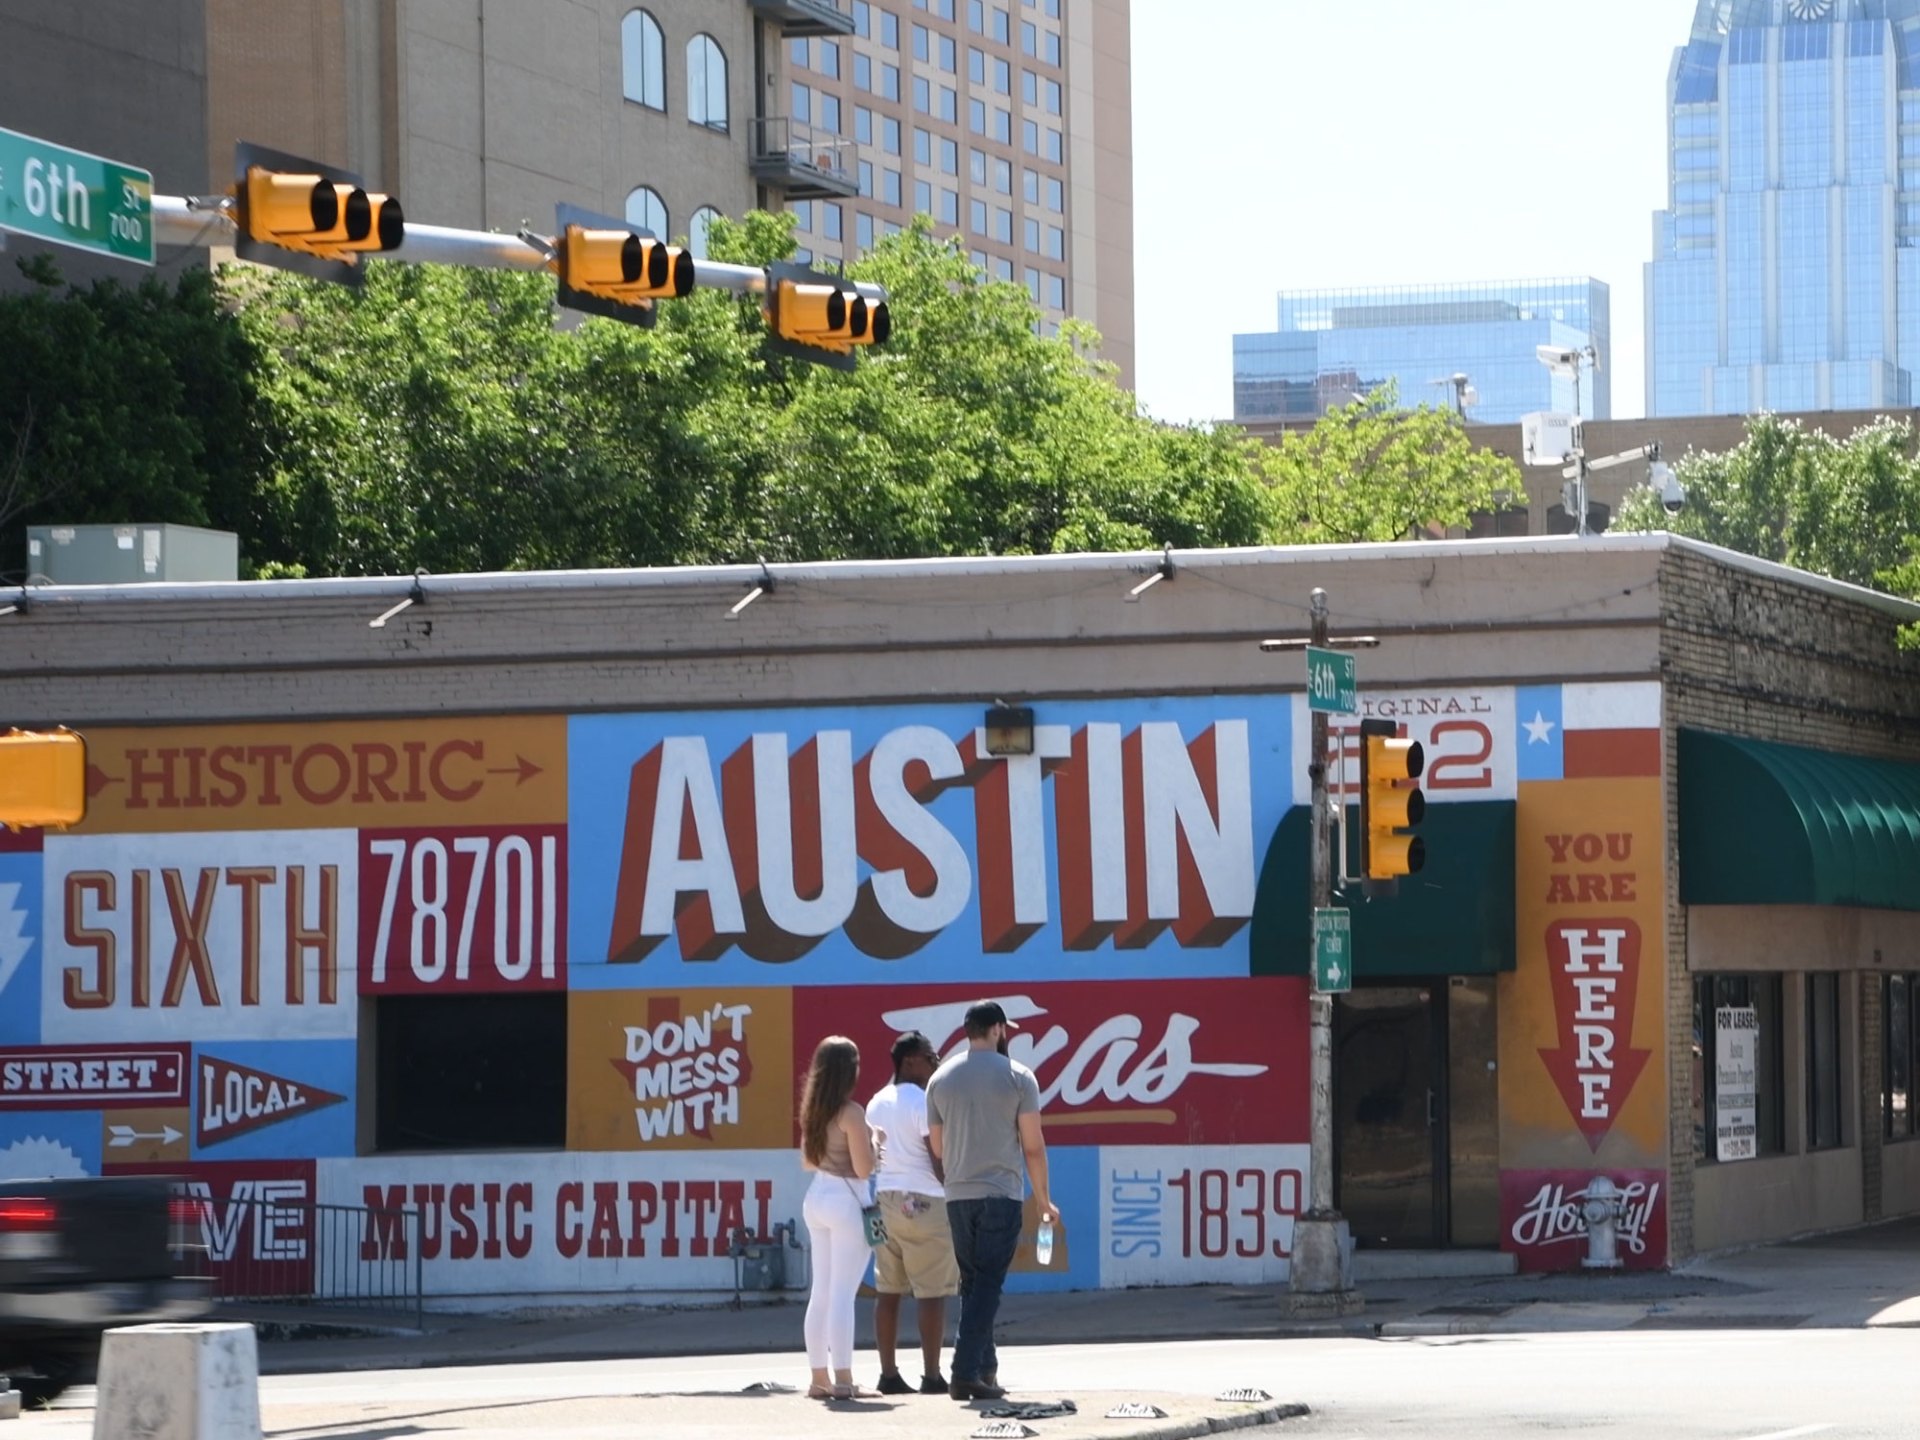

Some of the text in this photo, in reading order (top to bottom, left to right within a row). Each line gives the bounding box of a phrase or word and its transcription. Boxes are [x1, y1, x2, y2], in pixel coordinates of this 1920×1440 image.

[24, 157, 90, 231] 6th
[108, 212, 142, 242] 700
[1315, 661, 1335, 701] 6th
[125, 740, 484, 809] HISTORIC
[606, 719, 1254, 963] AUSTIN
[1545, 833, 1632, 863] YOU
[370, 835, 556, 983] 78701
[1545, 873, 1636, 903] ARE
[63, 864, 339, 1009] SIXTH
[624, 1002, 752, 1063] DON'T
[1560, 929, 1625, 1118] HERE
[1718, 1011, 1753, 1029] FOR LEASE
[3, 1060, 157, 1091] STREET
[203, 1064, 306, 1131] LOCAL
[636, 1047, 740, 1101] MESS
[635, 1085, 739, 1142] WITH
[361, 1183, 533, 1260] MUSIC
[1111, 1168, 1303, 1259] SINCE 1839
